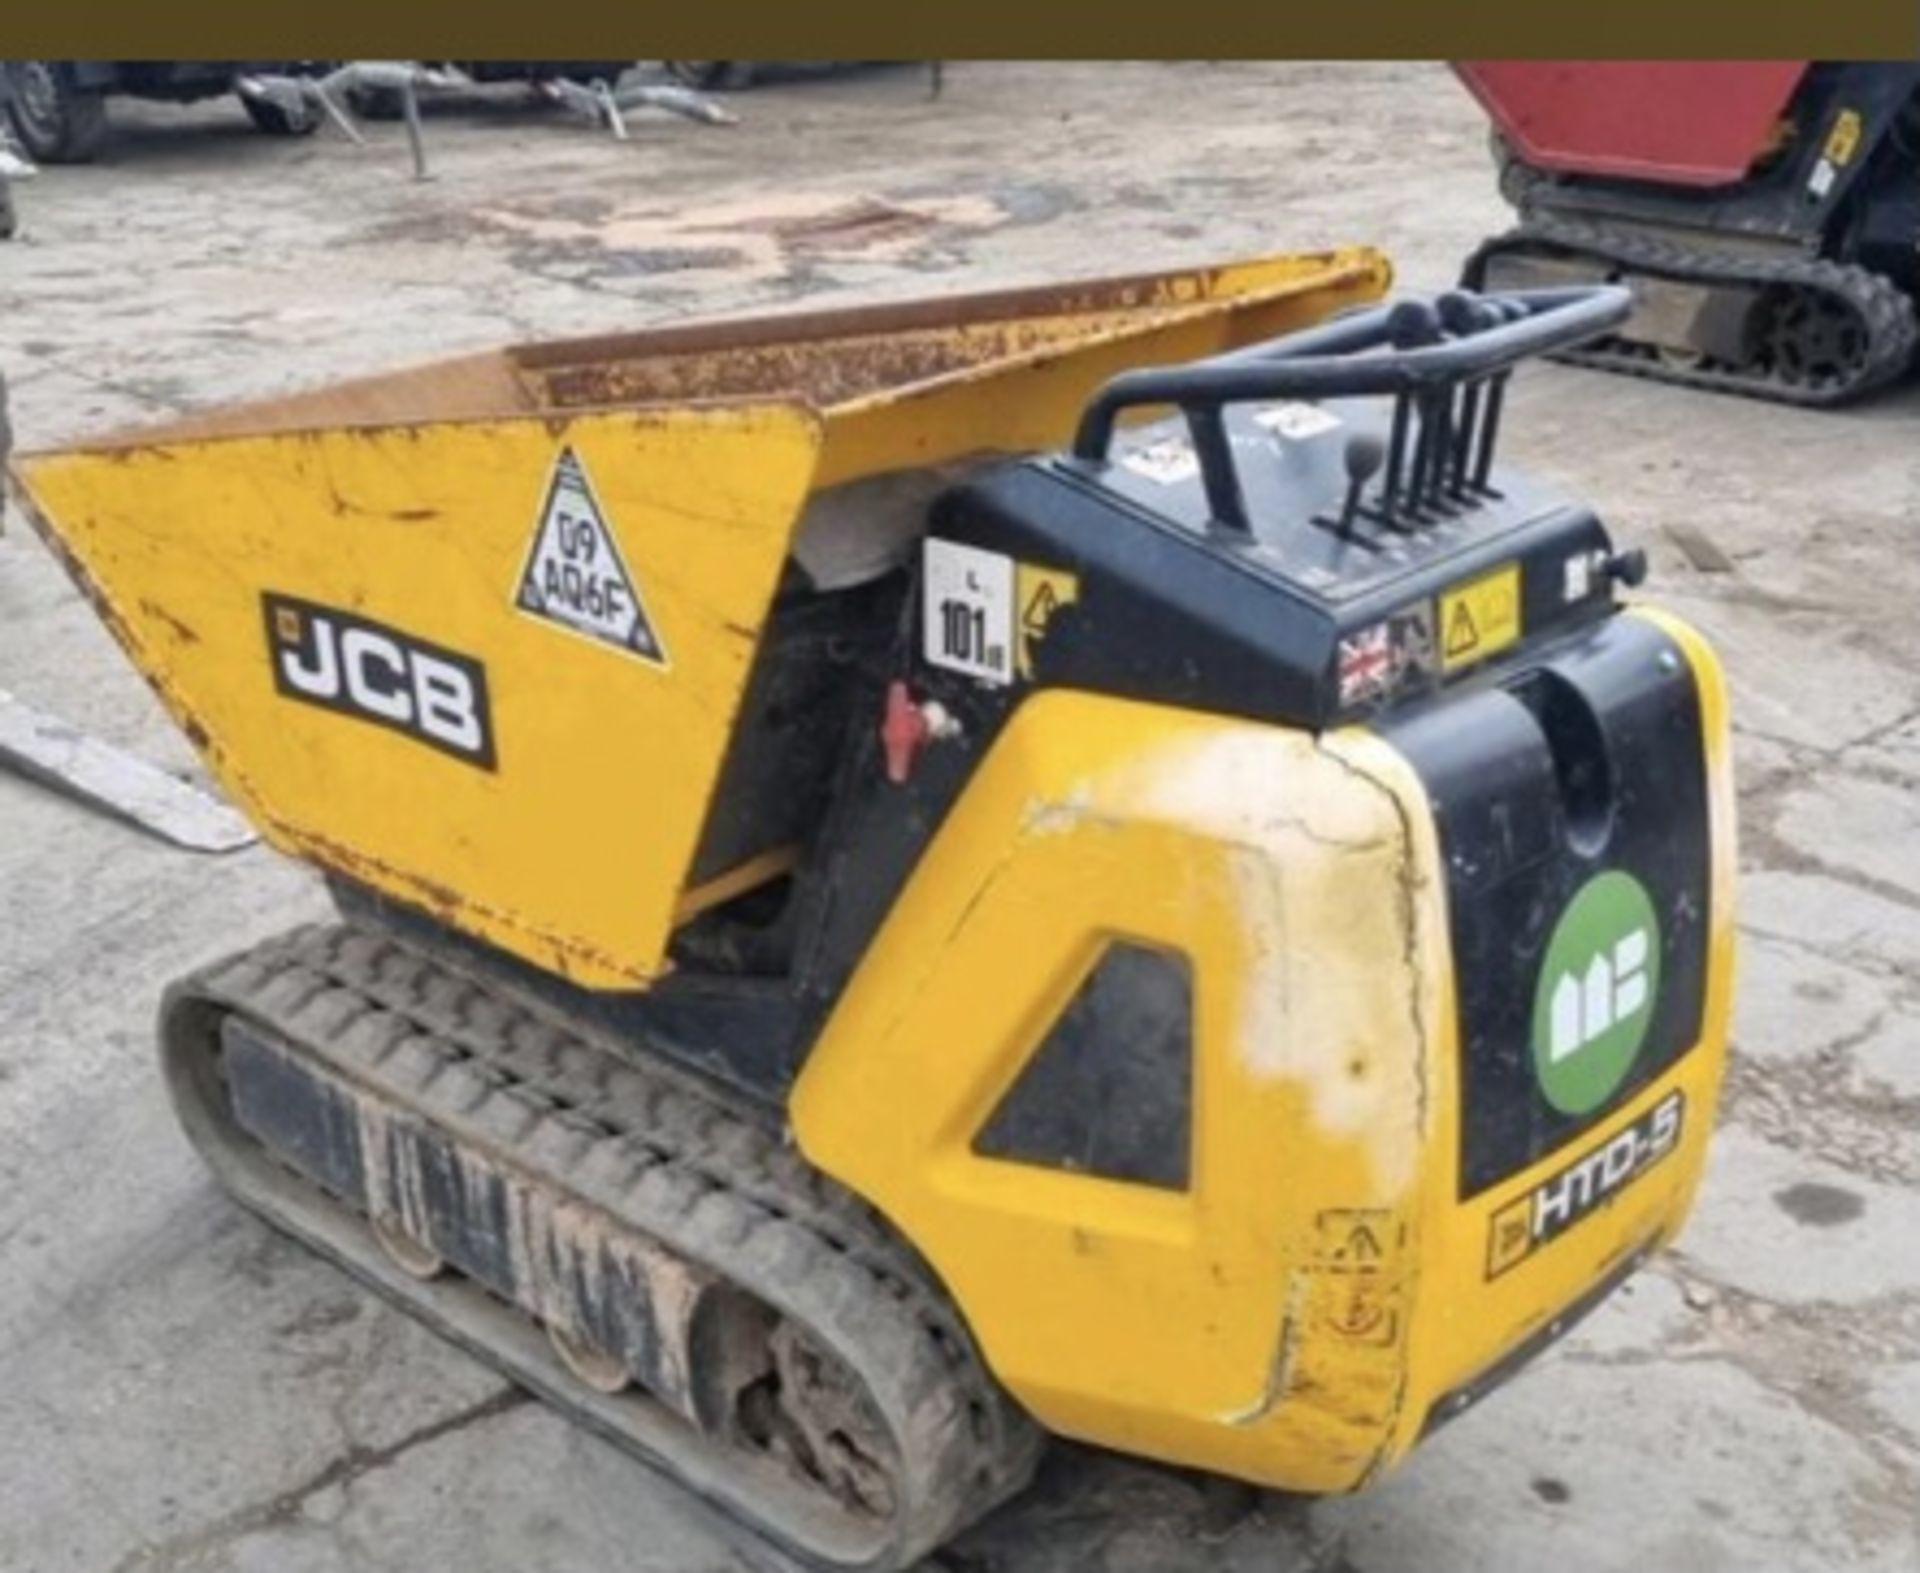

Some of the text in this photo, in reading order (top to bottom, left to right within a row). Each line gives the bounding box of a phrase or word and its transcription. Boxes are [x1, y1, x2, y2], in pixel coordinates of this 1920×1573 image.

[282, 617, 483, 751] JCB
[940, 598, 985, 664] 101
[1533, 1094, 1679, 1237] HTD-5
